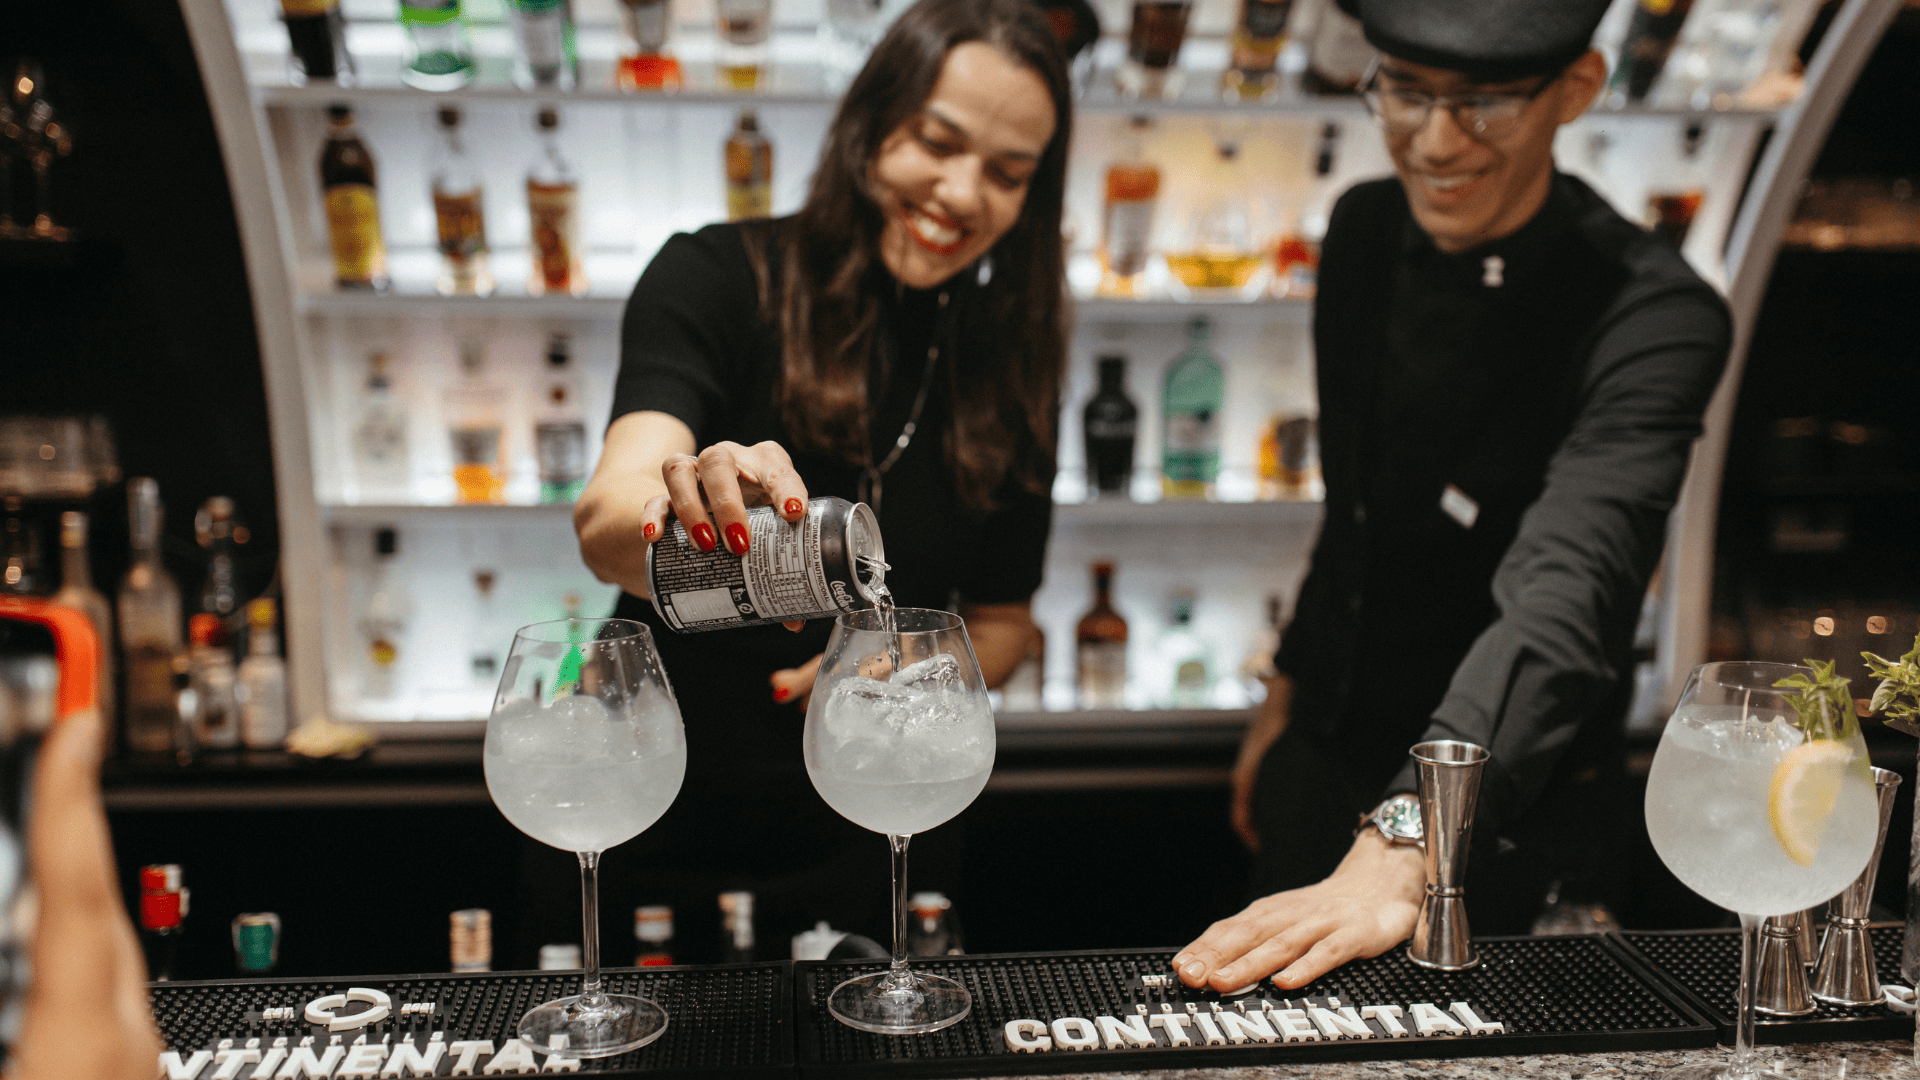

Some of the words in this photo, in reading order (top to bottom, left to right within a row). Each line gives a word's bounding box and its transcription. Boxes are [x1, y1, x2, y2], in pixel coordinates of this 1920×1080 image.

[811, 516, 820, 559] INFORMAÇÃO
[815, 562, 831, 603] NUTRICIONAL
[1141, 974, 1173, 986] EST.
[1136, 996, 1341, 1016] COCKTAILS
[218, 1030, 444, 1050] COCKTAILS
[1004, 1001, 1504, 1054] CONTINENTAL
[158, 1033, 581, 1080] NTINENTAL
